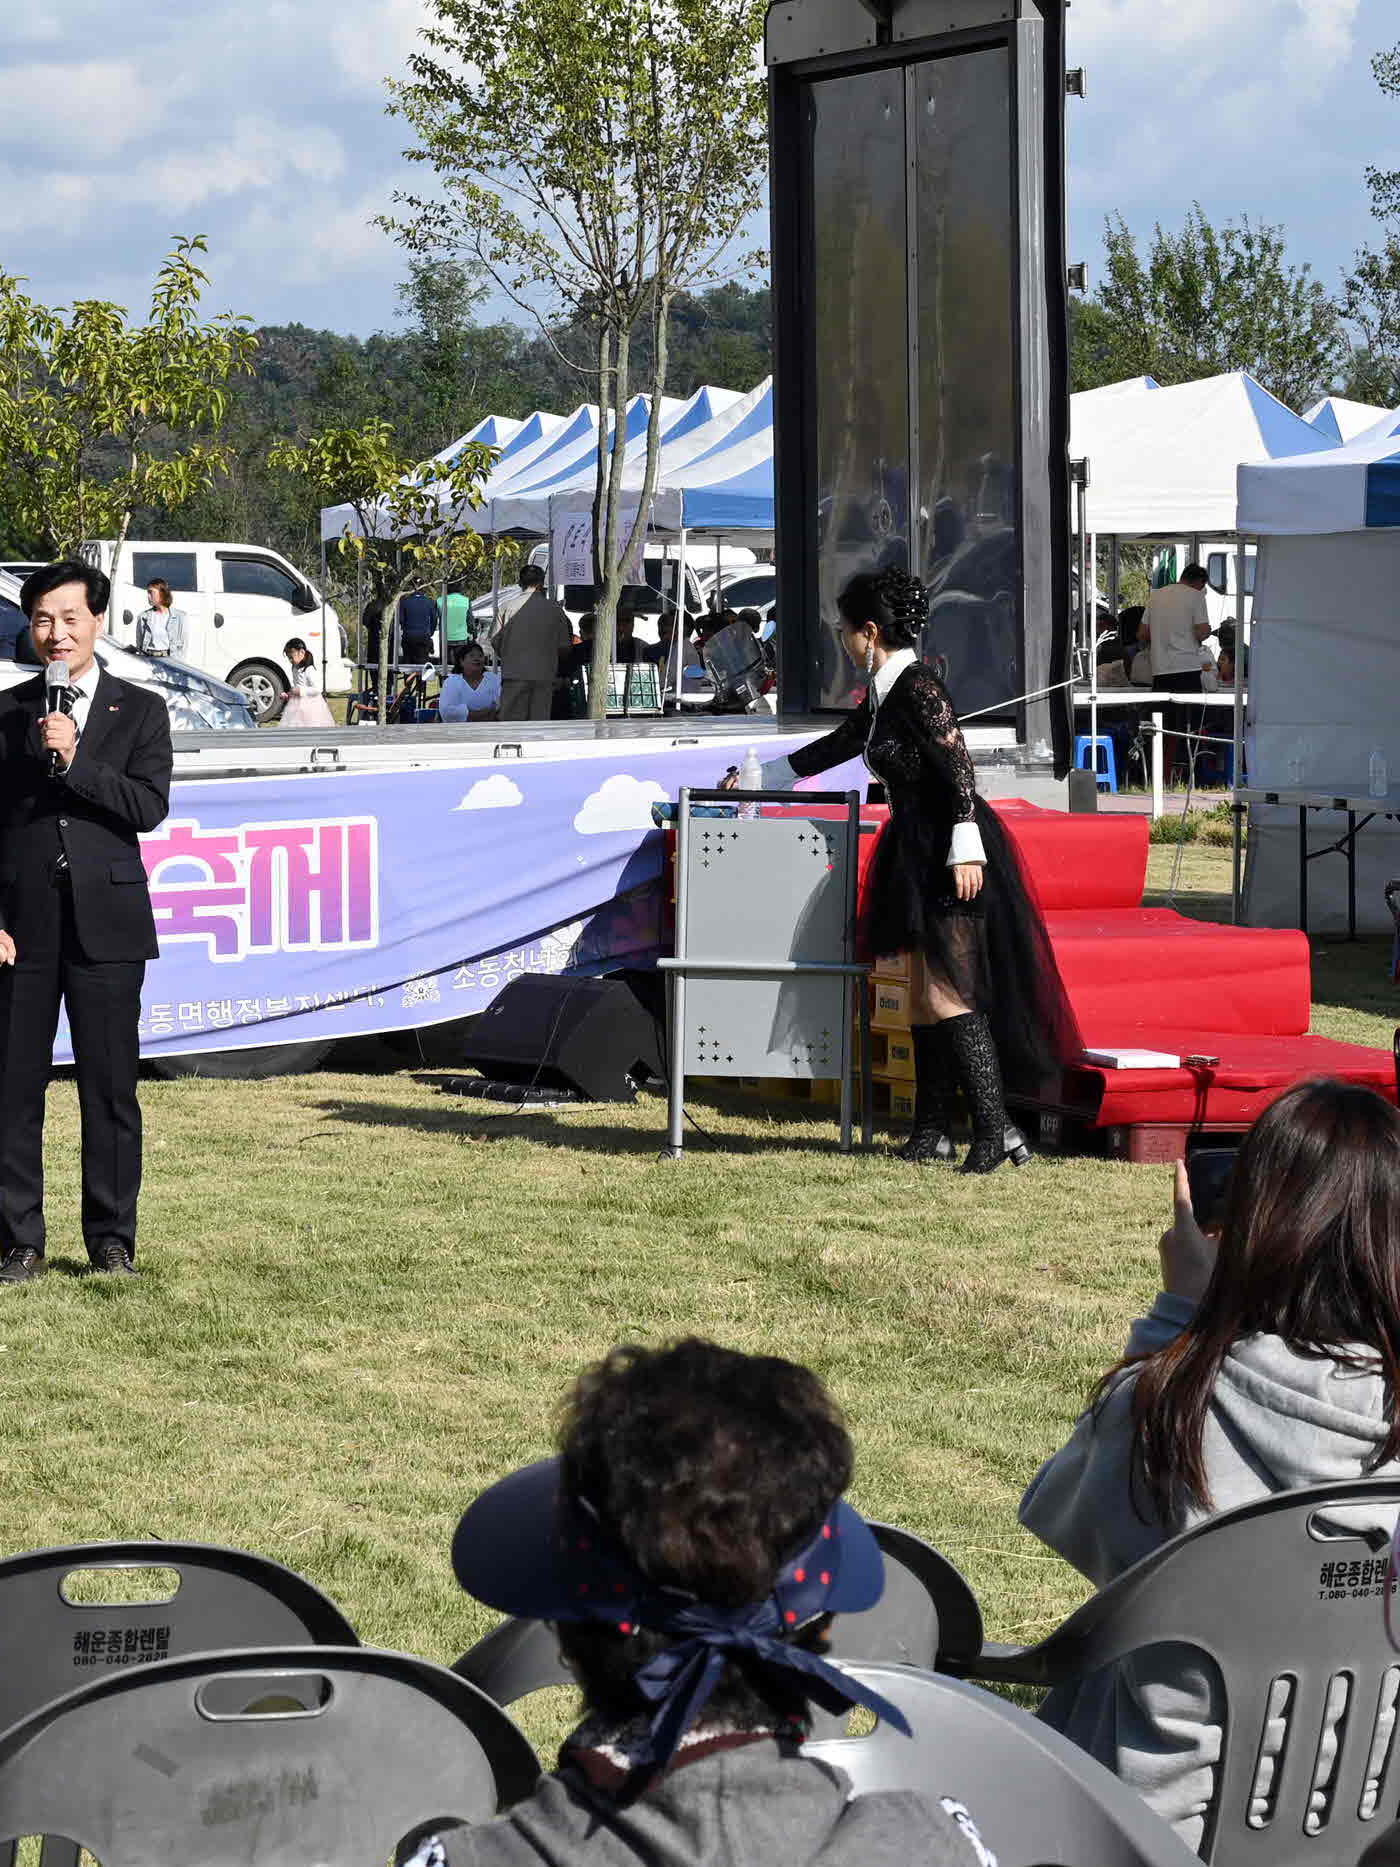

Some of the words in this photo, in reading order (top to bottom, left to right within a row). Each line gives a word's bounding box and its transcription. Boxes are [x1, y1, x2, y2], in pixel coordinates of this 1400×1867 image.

[138, 817, 379, 963] 축제
[138, 985, 386, 1034] 동면행정복지센터,
[1320, 1559, 1397, 1589] 해운종합렌
[73, 1625, 171, 1655] 해운종합렌탈
